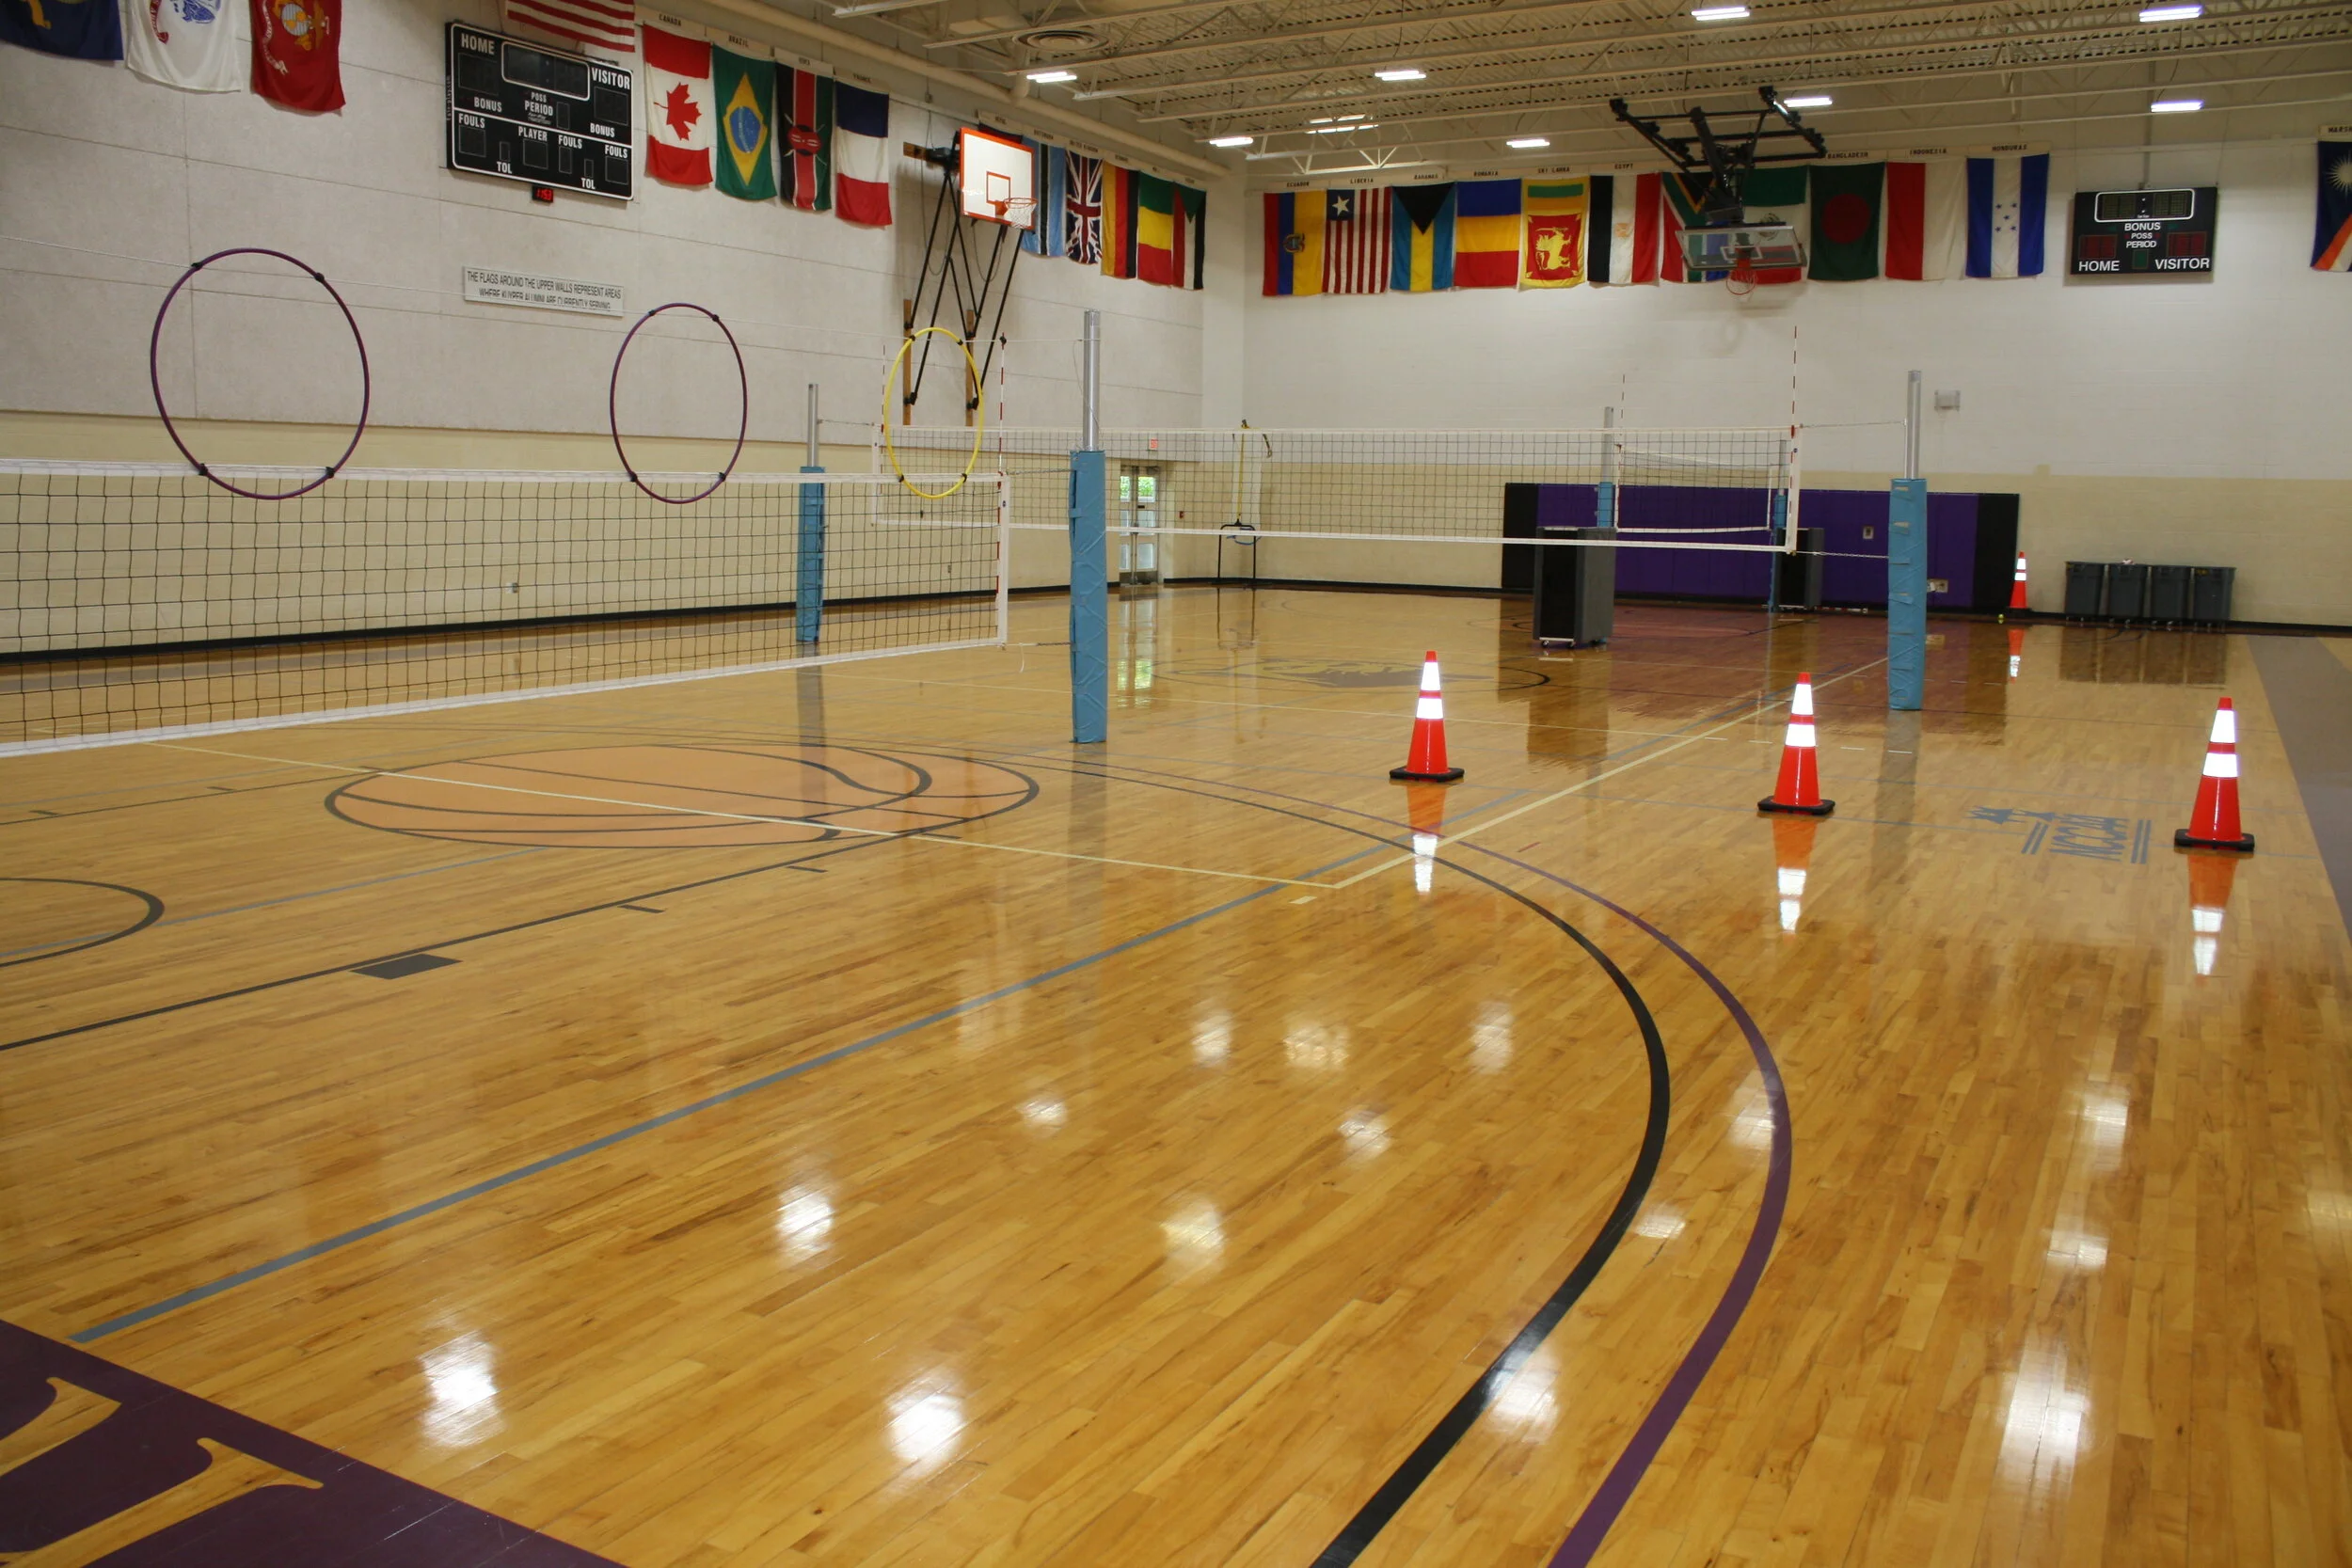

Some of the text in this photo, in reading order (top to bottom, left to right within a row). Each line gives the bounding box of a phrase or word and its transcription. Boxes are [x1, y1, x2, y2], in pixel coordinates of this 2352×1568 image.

[659, 13, 682, 26] CANADA
[461, 33, 495, 55] HOME
[728, 35, 749, 48] BRAZIL
[591, 67, 630, 90] VISITOR
[531, 91, 548, 103] POSS
[473, 96, 502, 113] BONUS
[524, 101, 553, 117] PERIOD
[458, 113, 485, 129] FOULS
[518, 126, 548, 142] PLAYER
[590, 122, 615, 138] BONUS
[558, 135, 582, 150] FOULS
[1992, 144, 2028, 152] HONDURAS
[605, 144, 628, 159] FOULS
[497, 161, 513, 174] TOL
[581, 177, 596, 190] TOL
[2124, 222, 2161, 232] BONUS
[2125, 240, 2157, 249] PERIOD
[2078, 260, 2120, 272] HOME
[2154, 257, 2210, 271] VISITOR
[467, 271, 621, 299] THE FLAGS AROUND THE UPPER WALLS REPRESENT AREAS
[478, 287, 501, 298] WHERE
